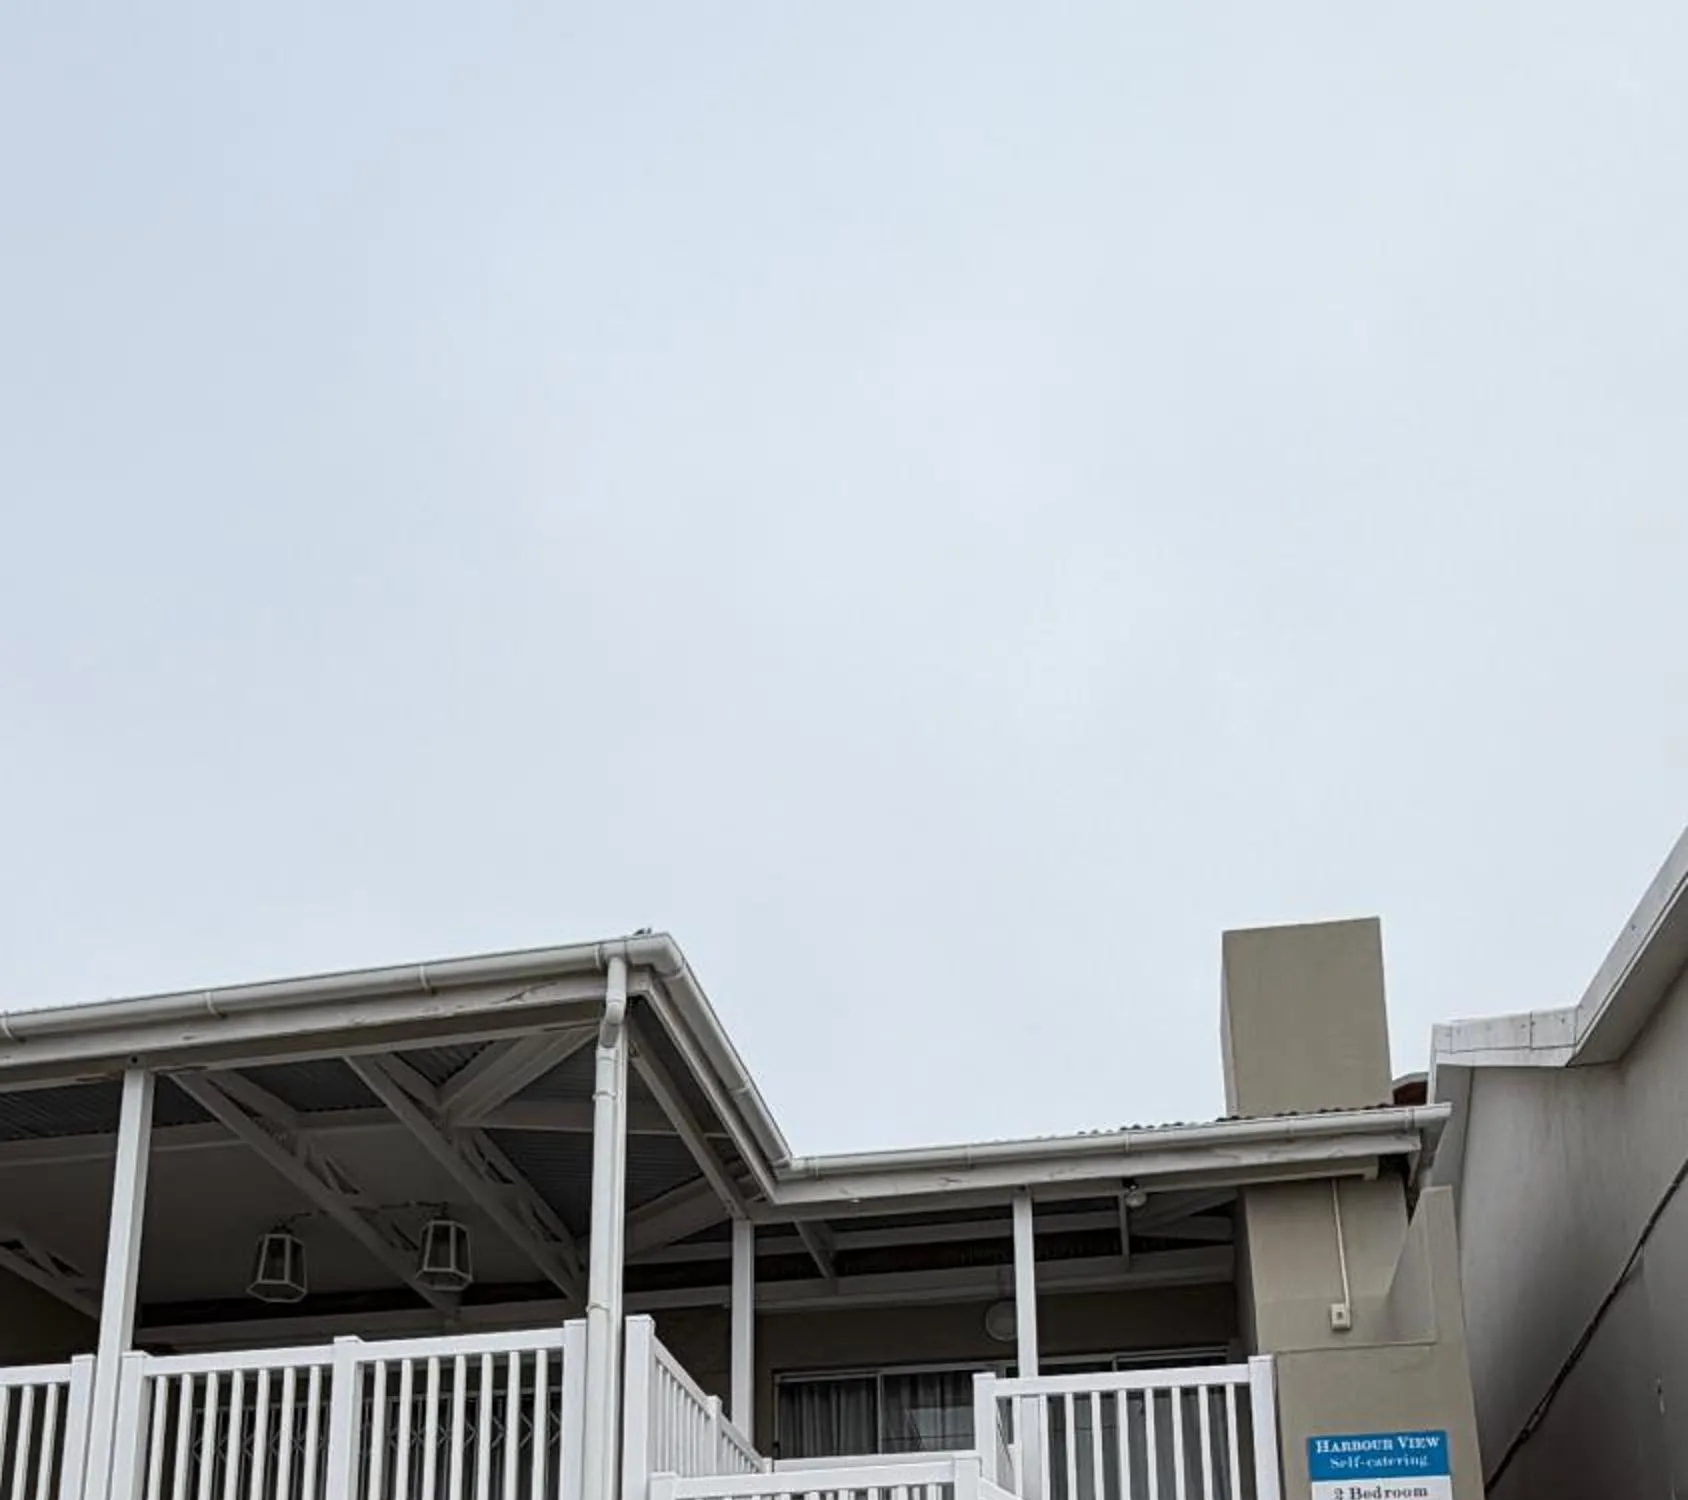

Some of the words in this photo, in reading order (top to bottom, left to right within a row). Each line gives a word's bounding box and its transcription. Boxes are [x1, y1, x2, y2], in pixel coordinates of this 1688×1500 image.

[1316, 1439, 1393, 1453] HARBOUR
[1397, 1435, 1440, 1449] VIEW
[1330, 1454, 1428, 1469] Self-catering
[1334, 1487, 1344, 1500] 2
[1350, 1485, 1428, 1500] Bedroom
